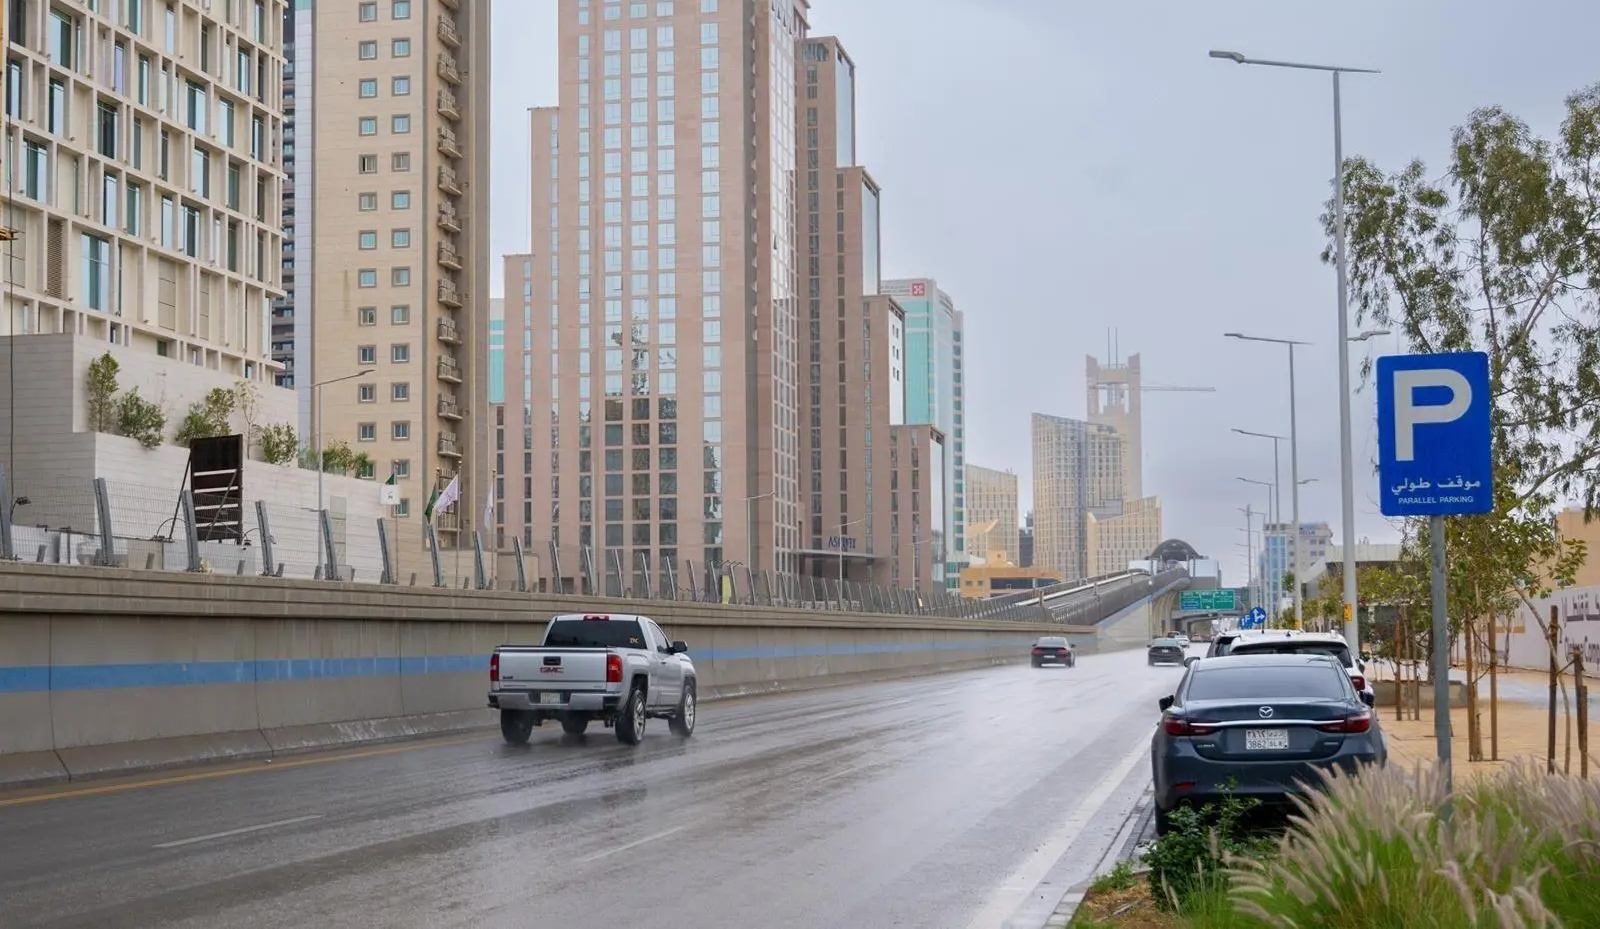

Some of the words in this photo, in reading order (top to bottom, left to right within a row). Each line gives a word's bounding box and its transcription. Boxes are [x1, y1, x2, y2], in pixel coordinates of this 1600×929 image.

[1393, 368, 1473, 461] P
[1391, 477, 1431, 495] طولي
[1437, 475, 1481, 491] موقف
[1439, 495, 1474, 503] PARKING
